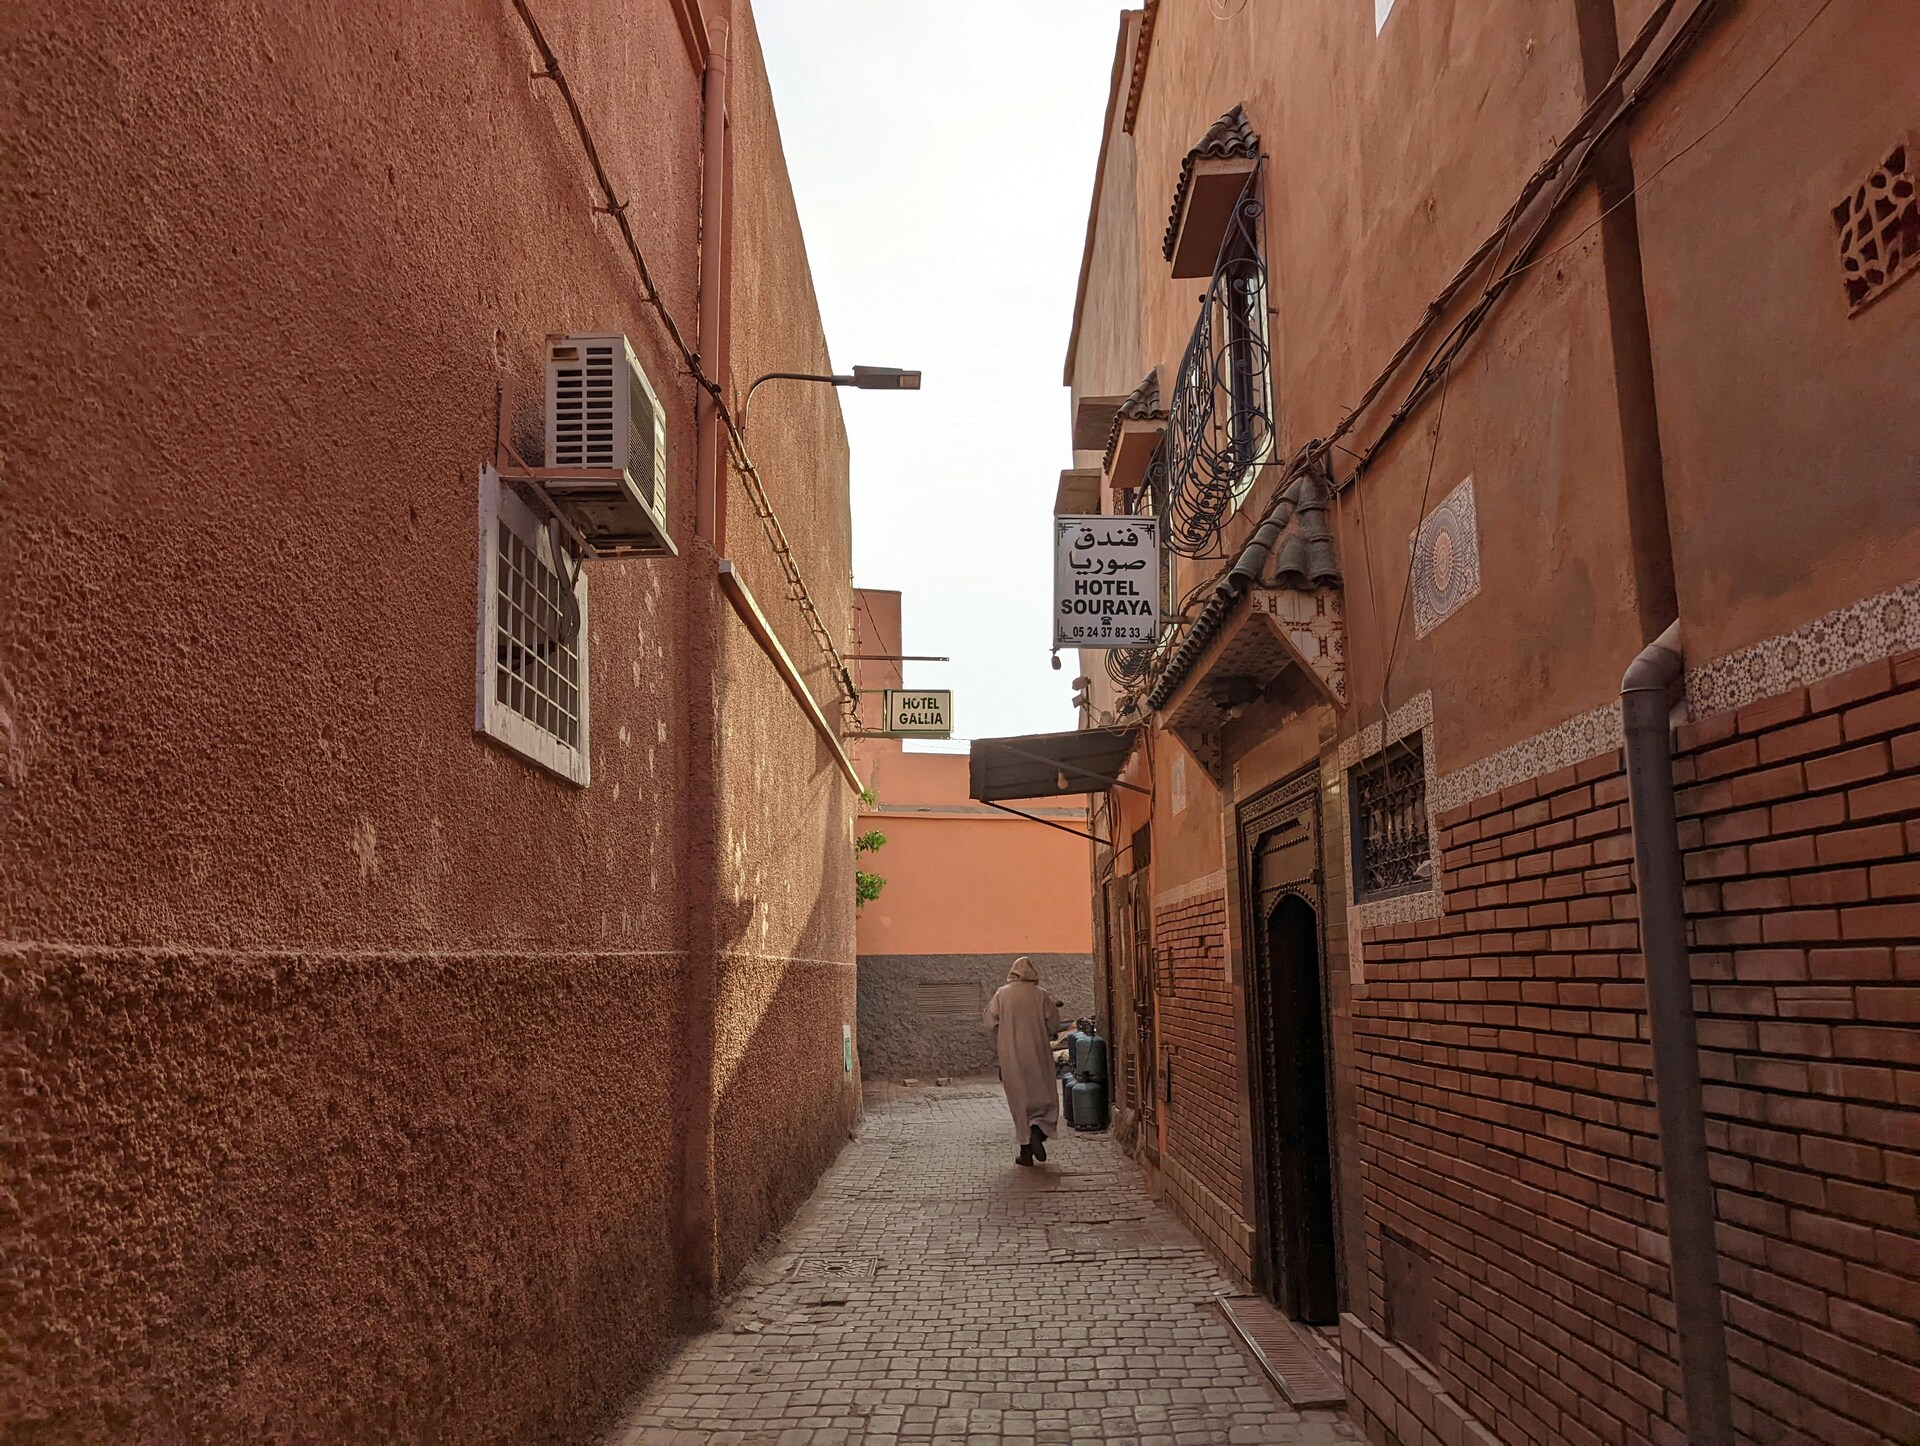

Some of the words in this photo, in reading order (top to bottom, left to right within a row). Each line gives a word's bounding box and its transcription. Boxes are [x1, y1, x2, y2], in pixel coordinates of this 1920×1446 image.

[1074, 527, 1139, 550] فندق
[1068, 550, 1147, 575] صوريا
[1074, 580, 1140, 596] HOTEL
[1061, 599, 1152, 616] SOURAYA
[1073, 626, 1084, 638] 05
[1086, 626, 1098, 638] 24
[1101, 627, 1113, 638] 37
[1115, 627, 1127, 638] 82
[1128, 627, 1140, 639] 33
[902, 697, 940, 709] HOTEL
[899, 712, 943, 725] GALLIA
